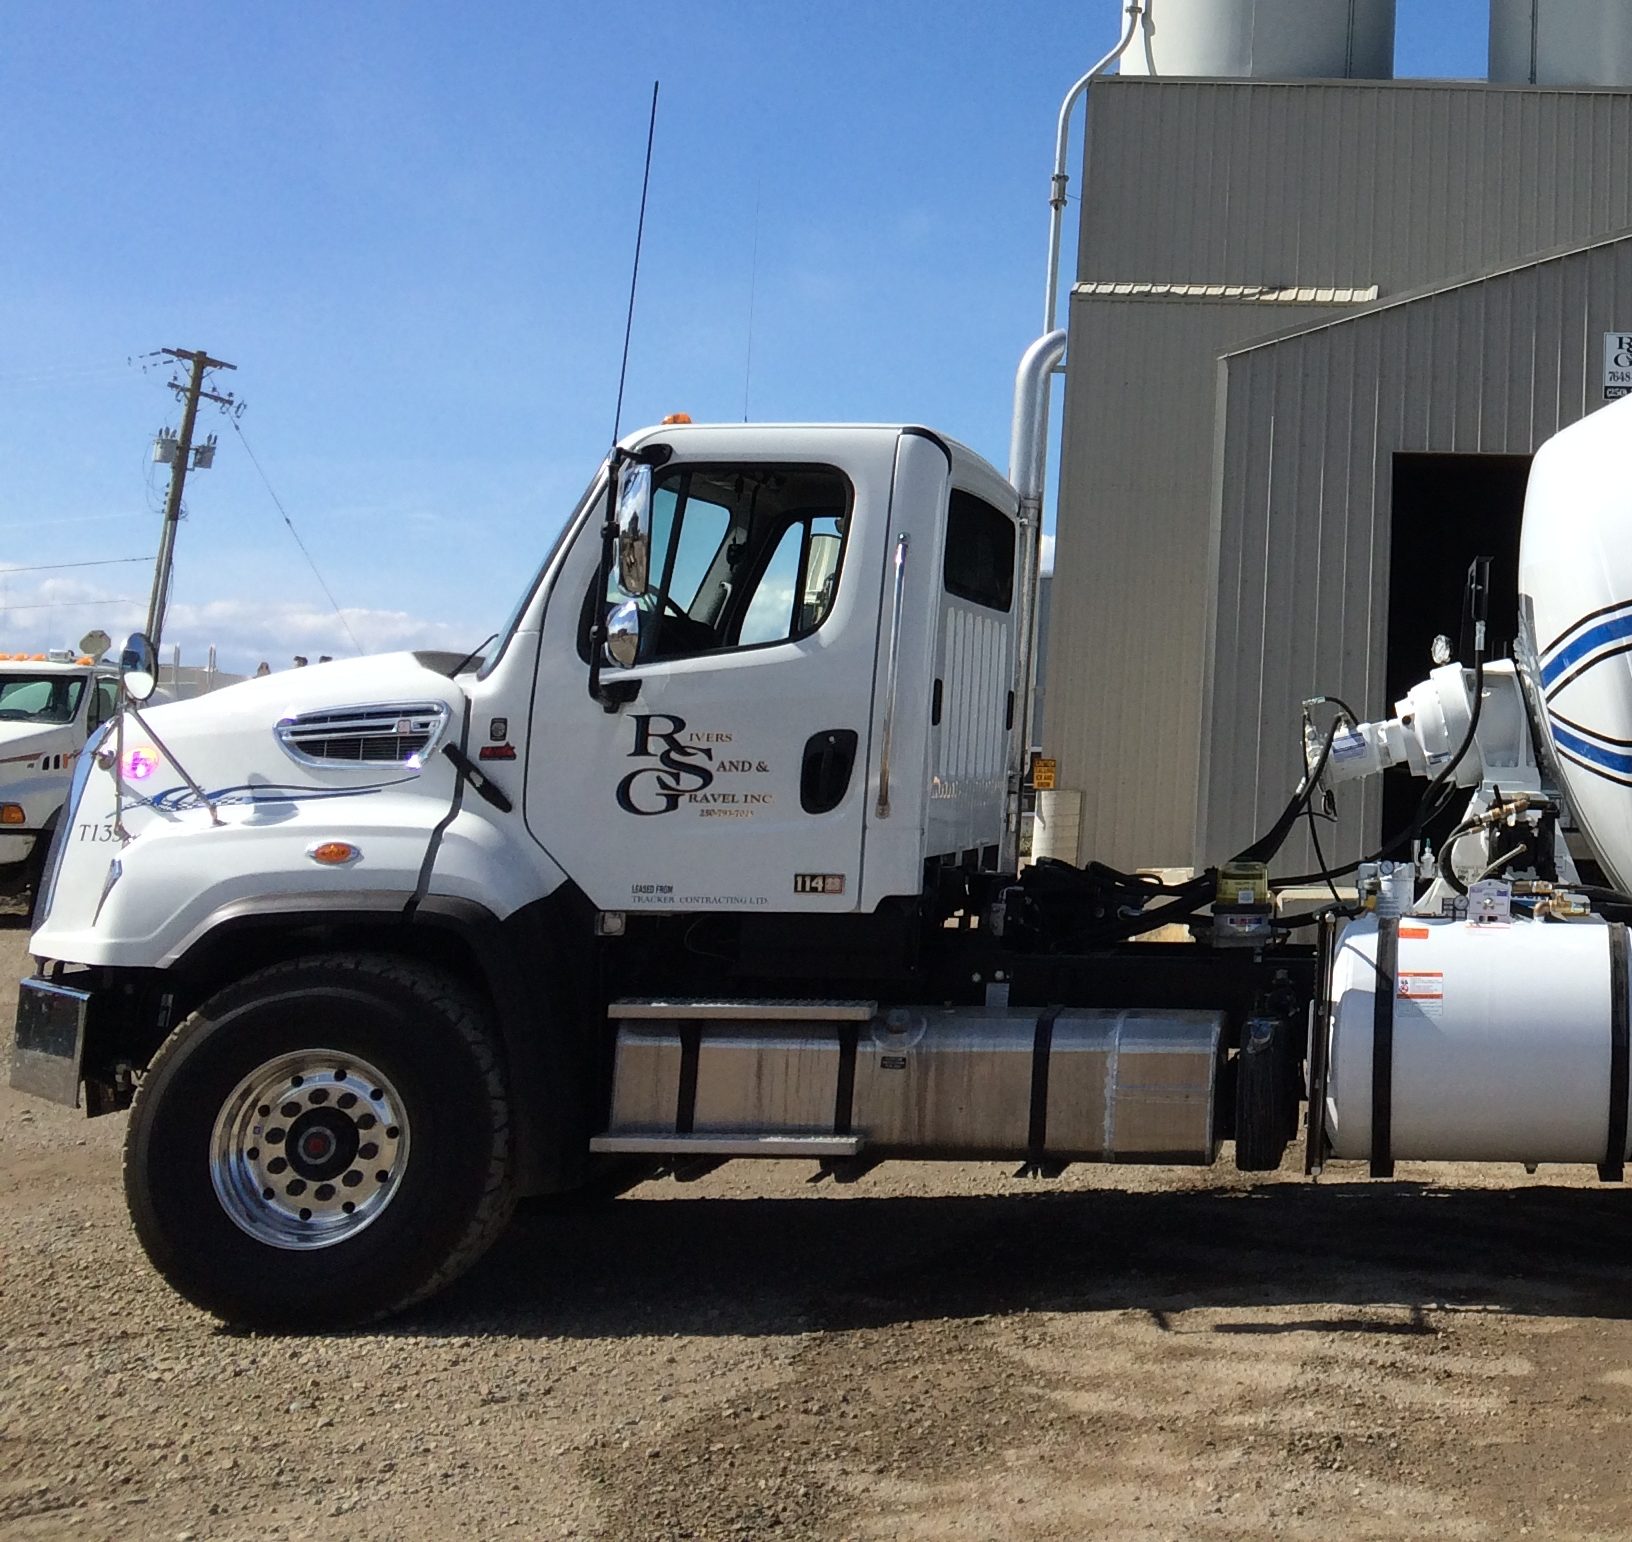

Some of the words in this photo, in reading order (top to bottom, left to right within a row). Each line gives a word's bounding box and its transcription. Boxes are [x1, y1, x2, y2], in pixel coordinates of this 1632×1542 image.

[716, 760, 752, 773] AND
[755, 760, 770, 773] &
[631, 884, 655, 894] LEASED
[656, 884, 674, 894] FROM
[632, 895, 675, 904] TRACKER
[679, 896, 747, 905] CONTRACTING
